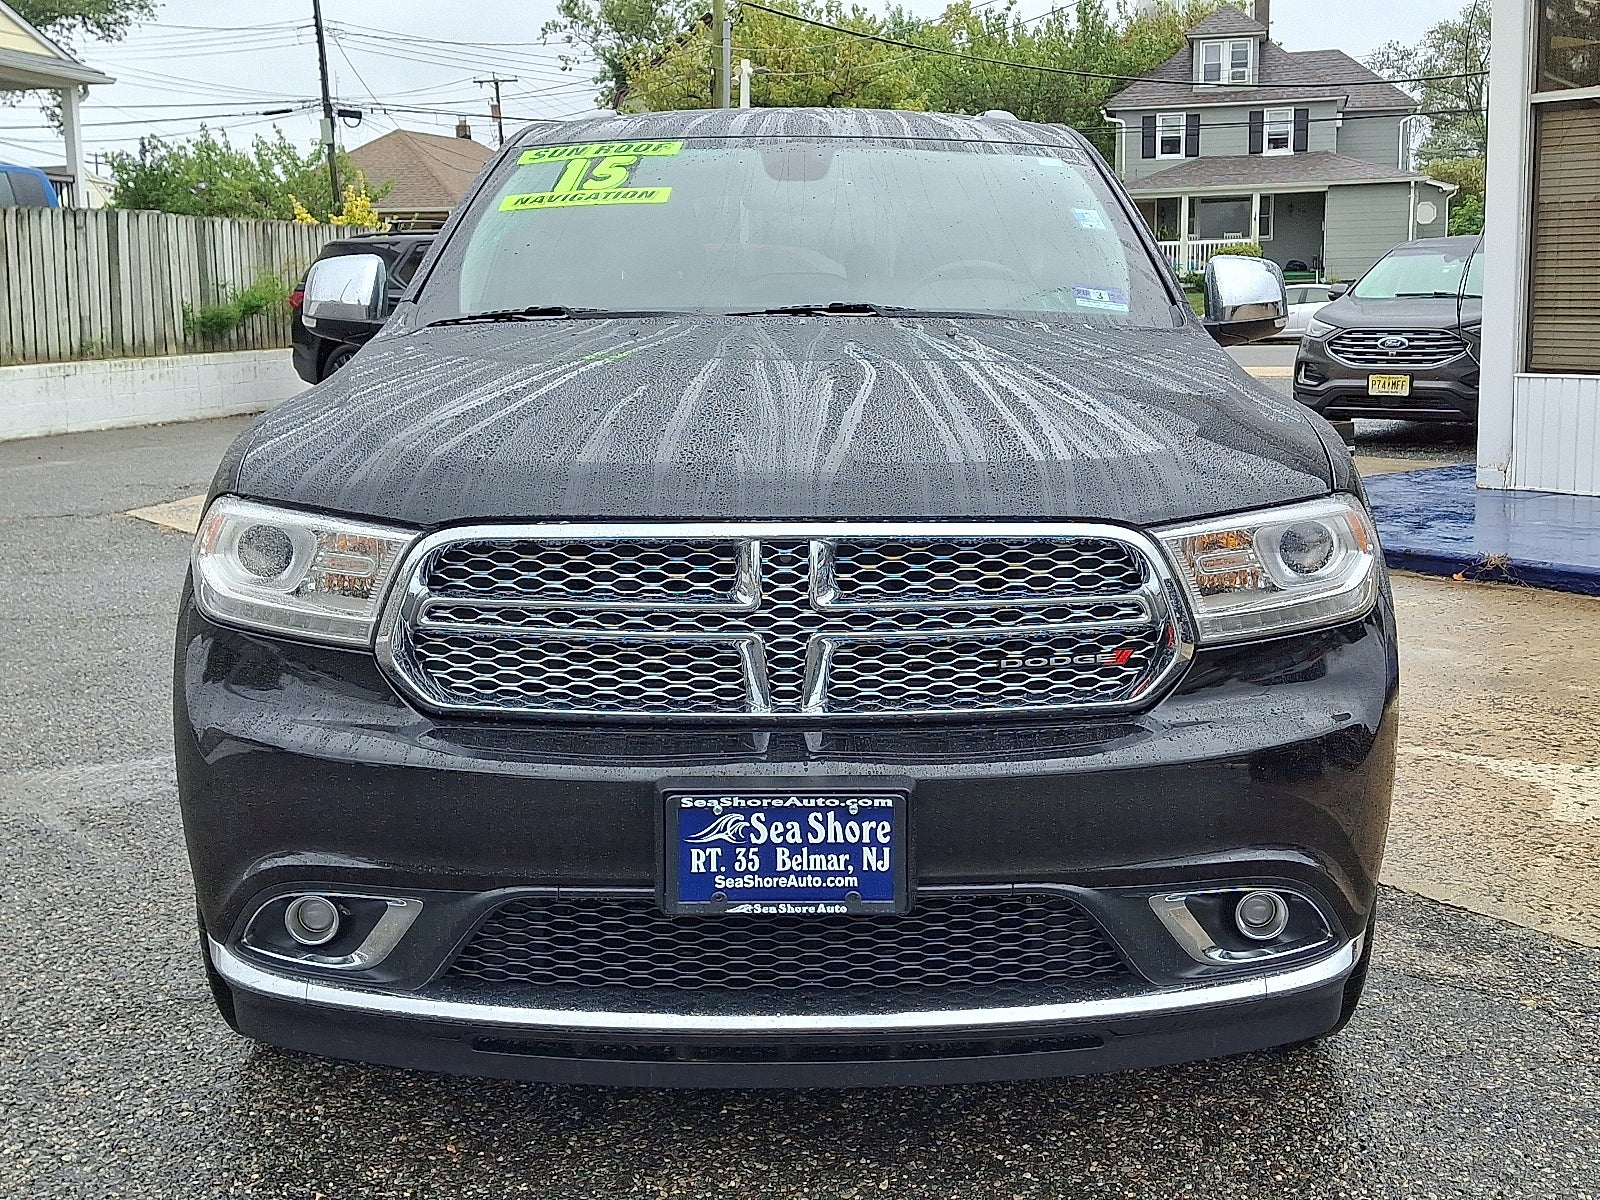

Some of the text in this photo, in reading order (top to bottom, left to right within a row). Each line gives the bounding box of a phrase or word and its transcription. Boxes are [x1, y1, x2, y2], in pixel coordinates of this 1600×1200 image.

[532, 143, 671, 159] SUN ROOF
[552, 156, 638, 192] 15
[514, 190, 655, 205] NAVIGATION
[1001, 654, 1117, 668] DODGE
[680, 796, 893, 809] SeaShoreAuto.com
[750, 811, 891, 844] Sea Shore
[690, 847, 891, 875] RT. 35 Belmar, NJ
[714, 875, 858, 889] SeaShoreAuto.com
[753, 903, 848, 914] Sea Shore Auto
